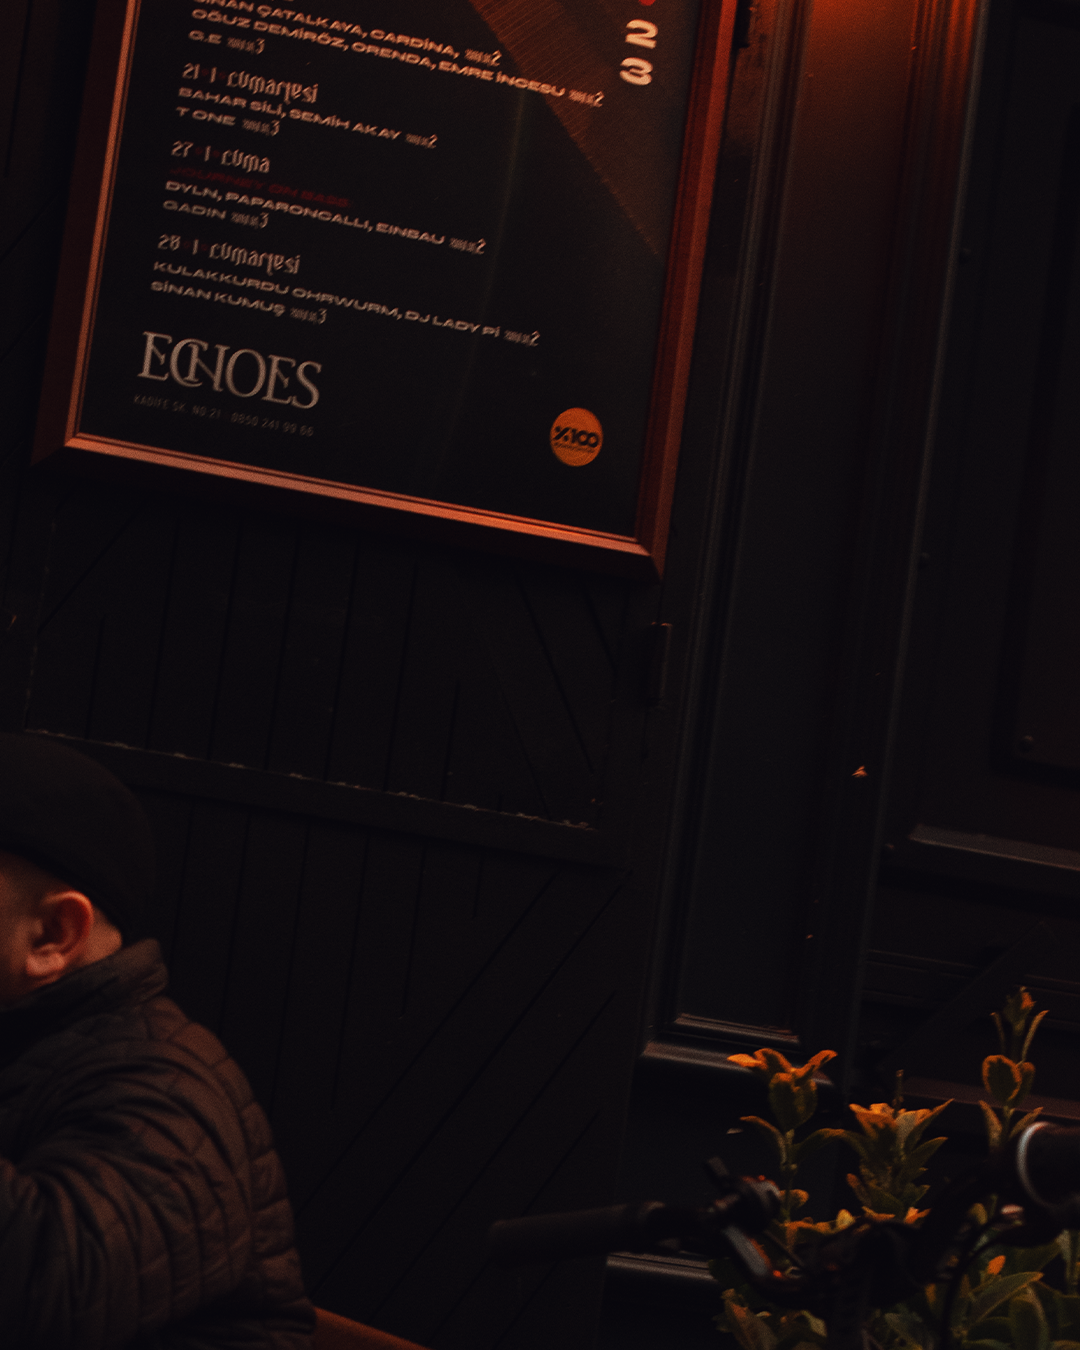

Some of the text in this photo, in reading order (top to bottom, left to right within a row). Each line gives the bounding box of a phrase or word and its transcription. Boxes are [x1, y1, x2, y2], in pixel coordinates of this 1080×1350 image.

[194, 0, 254, 13] NAN
[256, 4, 368, 39] ÇATALKAYA,
[182, 62, 201, 80] 21
[191, 8, 251, 29] OĞUZ
[253, 20, 349, 52] DEMİRÖZ,
[351, 41, 437, 71] ORENDA,
[438, 60, 494, 82] EMRE
[495, 70, 565, 98] İNCESU
[175, 106, 190, 117] T
[191, 109, 236, 126] ONE
[178, 86, 247, 109] BAHAR
[248, 99, 287, 120] SİLİ,
[288, 108, 351, 130] SEMİH
[351, 122, 402, 141] AKAY
[171, 140, 195, 158] 27
[267, 182, 299, 198] ON
[165, 180, 223, 202] DYLN,
[375, 221, 446, 246] EINBAU
[150, 279, 212, 301] SİNAN
[213, 292, 286, 318] KUMUŞ
[153, 260, 290, 295] KULAKKURDU
[291, 287, 403, 320] OHRWURM,
[404, 309, 431, 323] DJ
[432, 315, 481, 333] LADY
[137, 331, 322, 409] ECHOES
[553, 426, 599, 448] %100
